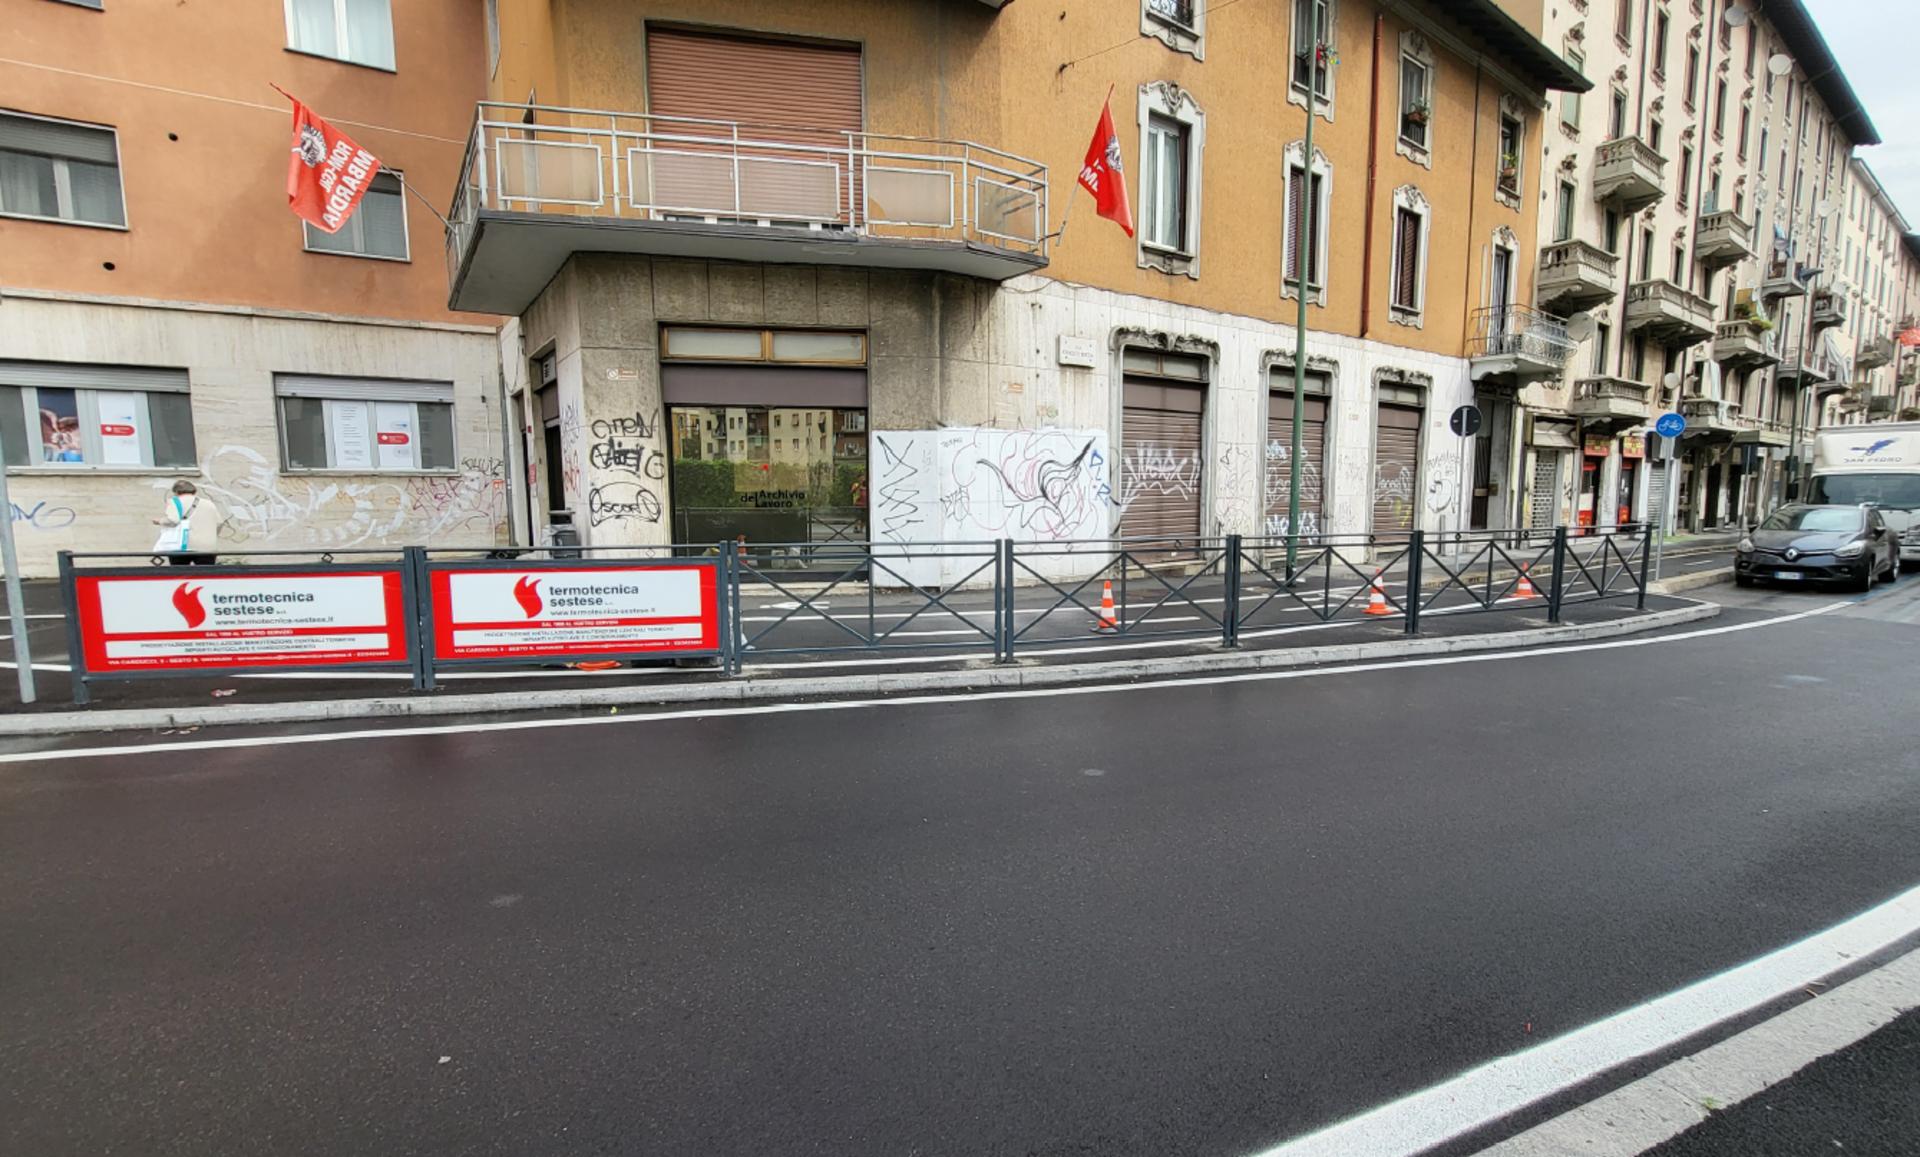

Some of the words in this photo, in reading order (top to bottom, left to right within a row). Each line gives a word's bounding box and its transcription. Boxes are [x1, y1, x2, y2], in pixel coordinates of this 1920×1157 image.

[755, 492, 793, 508] Lavoro
[759, 489, 806, 500] Archivio
[549, 584, 639, 596] termotecnica
[212, 591, 315, 604] termotecnica
[550, 596, 603, 607] sestese
[214, 604, 275, 616] sestese
